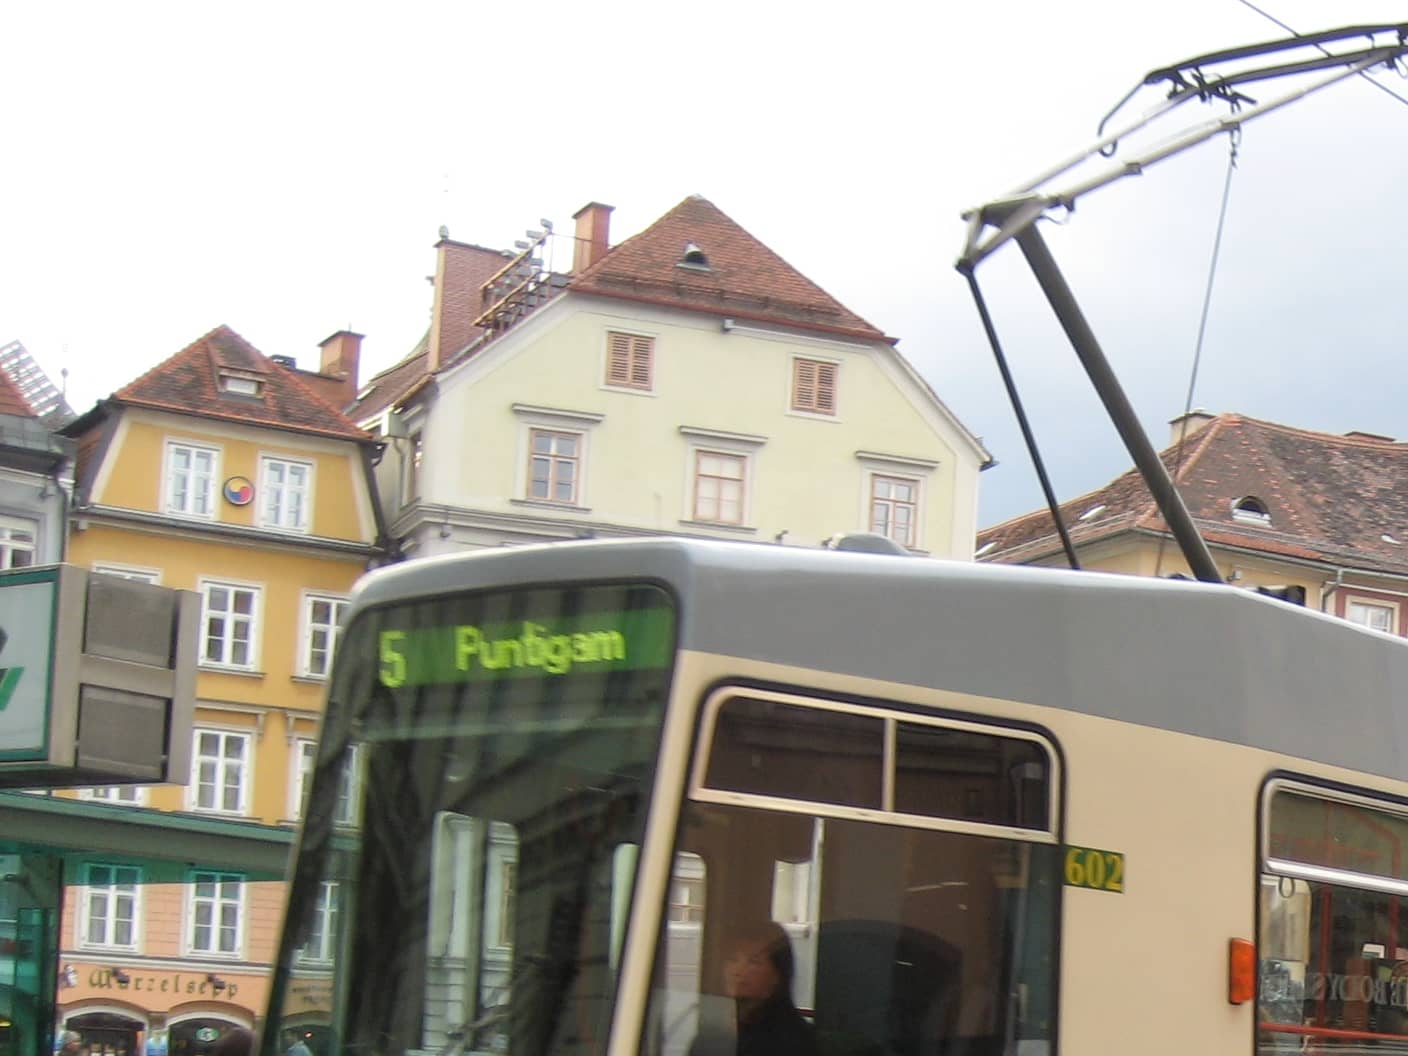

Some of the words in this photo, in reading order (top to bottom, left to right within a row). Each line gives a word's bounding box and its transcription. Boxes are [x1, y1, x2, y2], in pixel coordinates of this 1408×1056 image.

[379, 630, 407, 688] 5
[456, 620, 625, 674] Puntigam
[1065, 848, 1125, 889] 602
